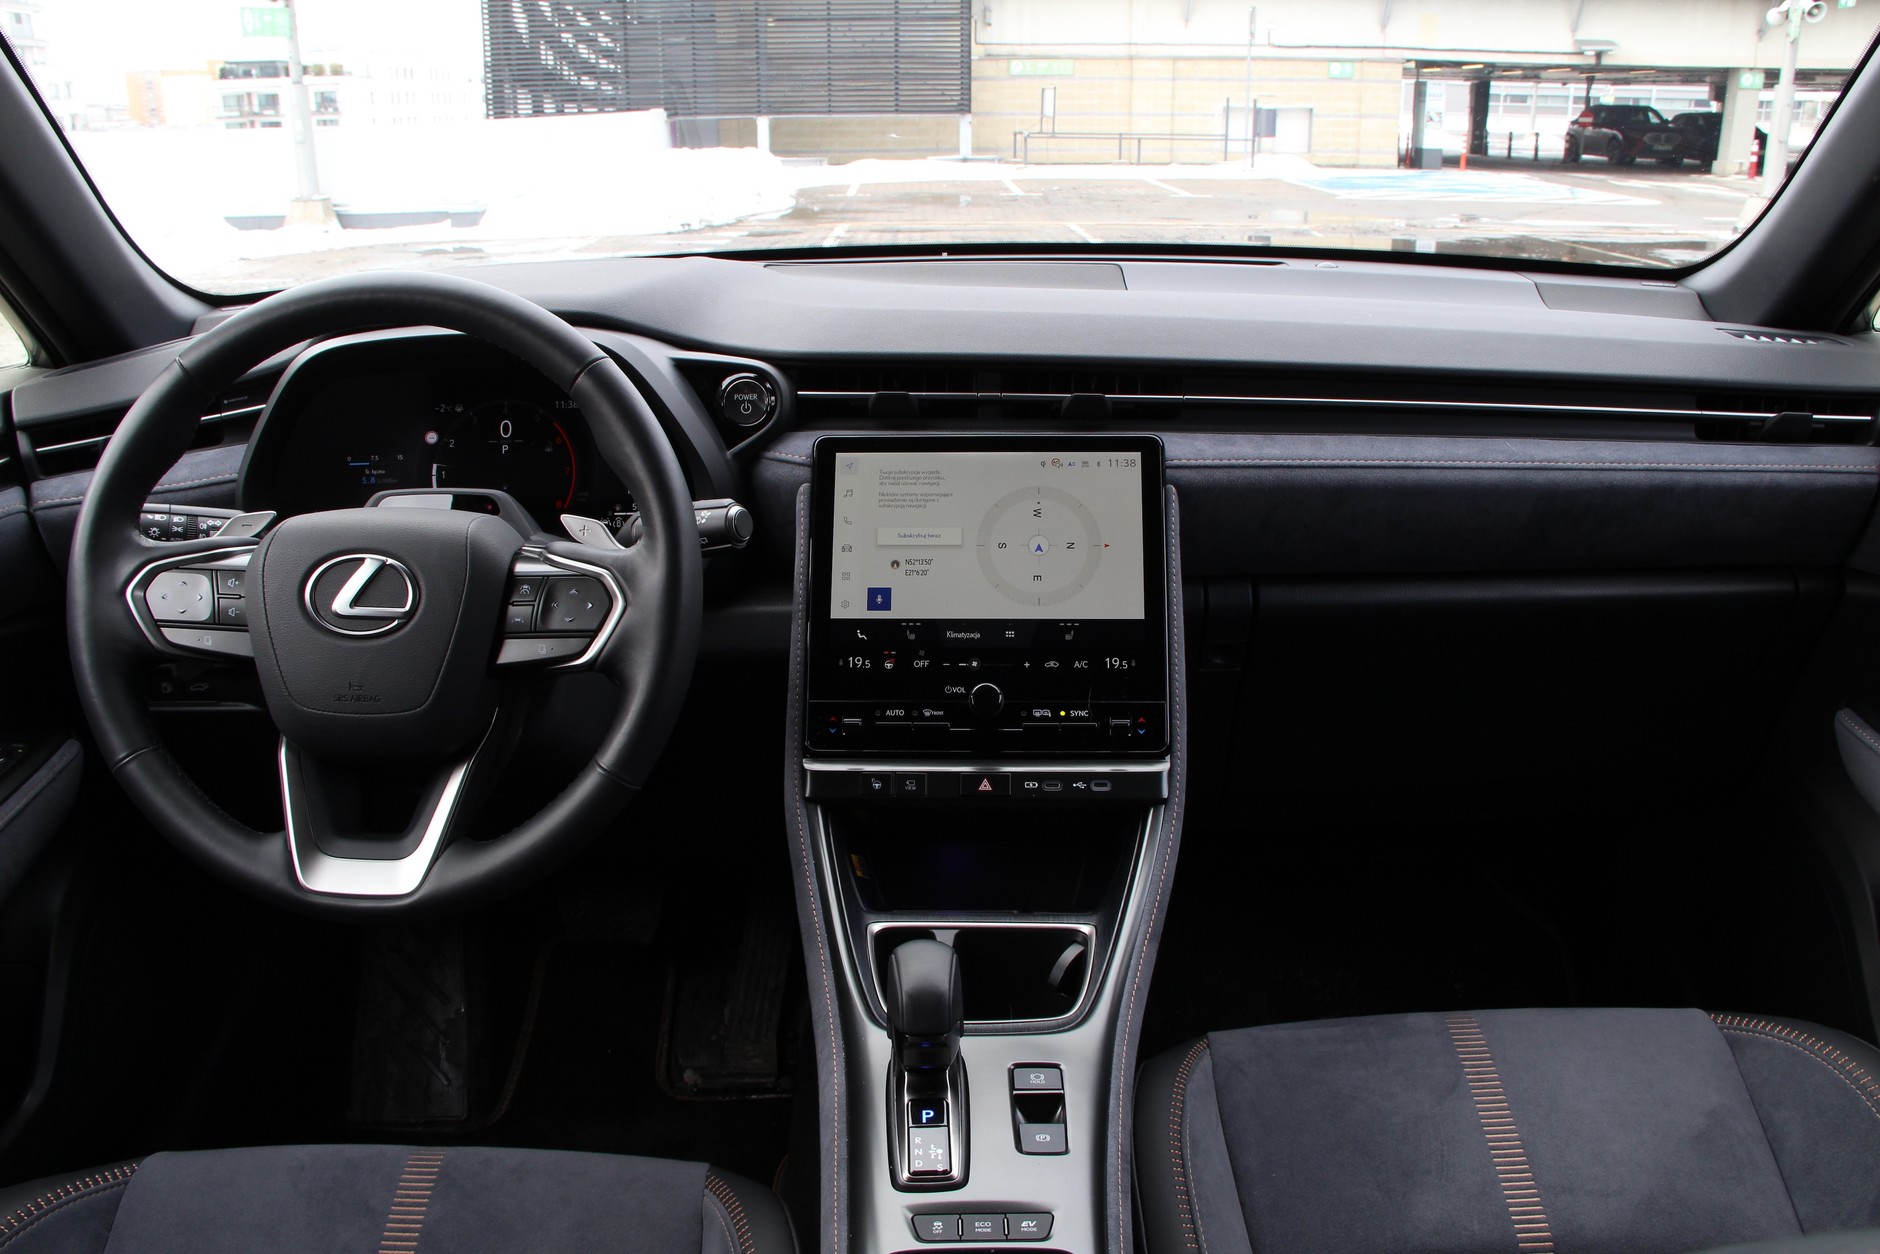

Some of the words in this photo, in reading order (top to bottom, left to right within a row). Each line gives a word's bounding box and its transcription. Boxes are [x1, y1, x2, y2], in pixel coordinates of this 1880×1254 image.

[500, 419, 512, 438] 0
[449, 440, 455, 448] 2
[502, 444, 508, 454] P
[1108, 459, 1137, 468] 11:38
[441, 470, 446, 478] 1
[1033, 508, 1042, 518] W
[946, 630, 981, 640] Klimatyzacja
[848, 657, 871, 669] 19.5
[1074, 660, 1088, 668] A/C
[1105, 658, 1128, 669] 19.5
[333, 694, 348, 702] SRS
[350, 694, 383, 703] AIRBAG
[922, 1110, 934, 1123] P
[937, 1163, 943, 1171] S
